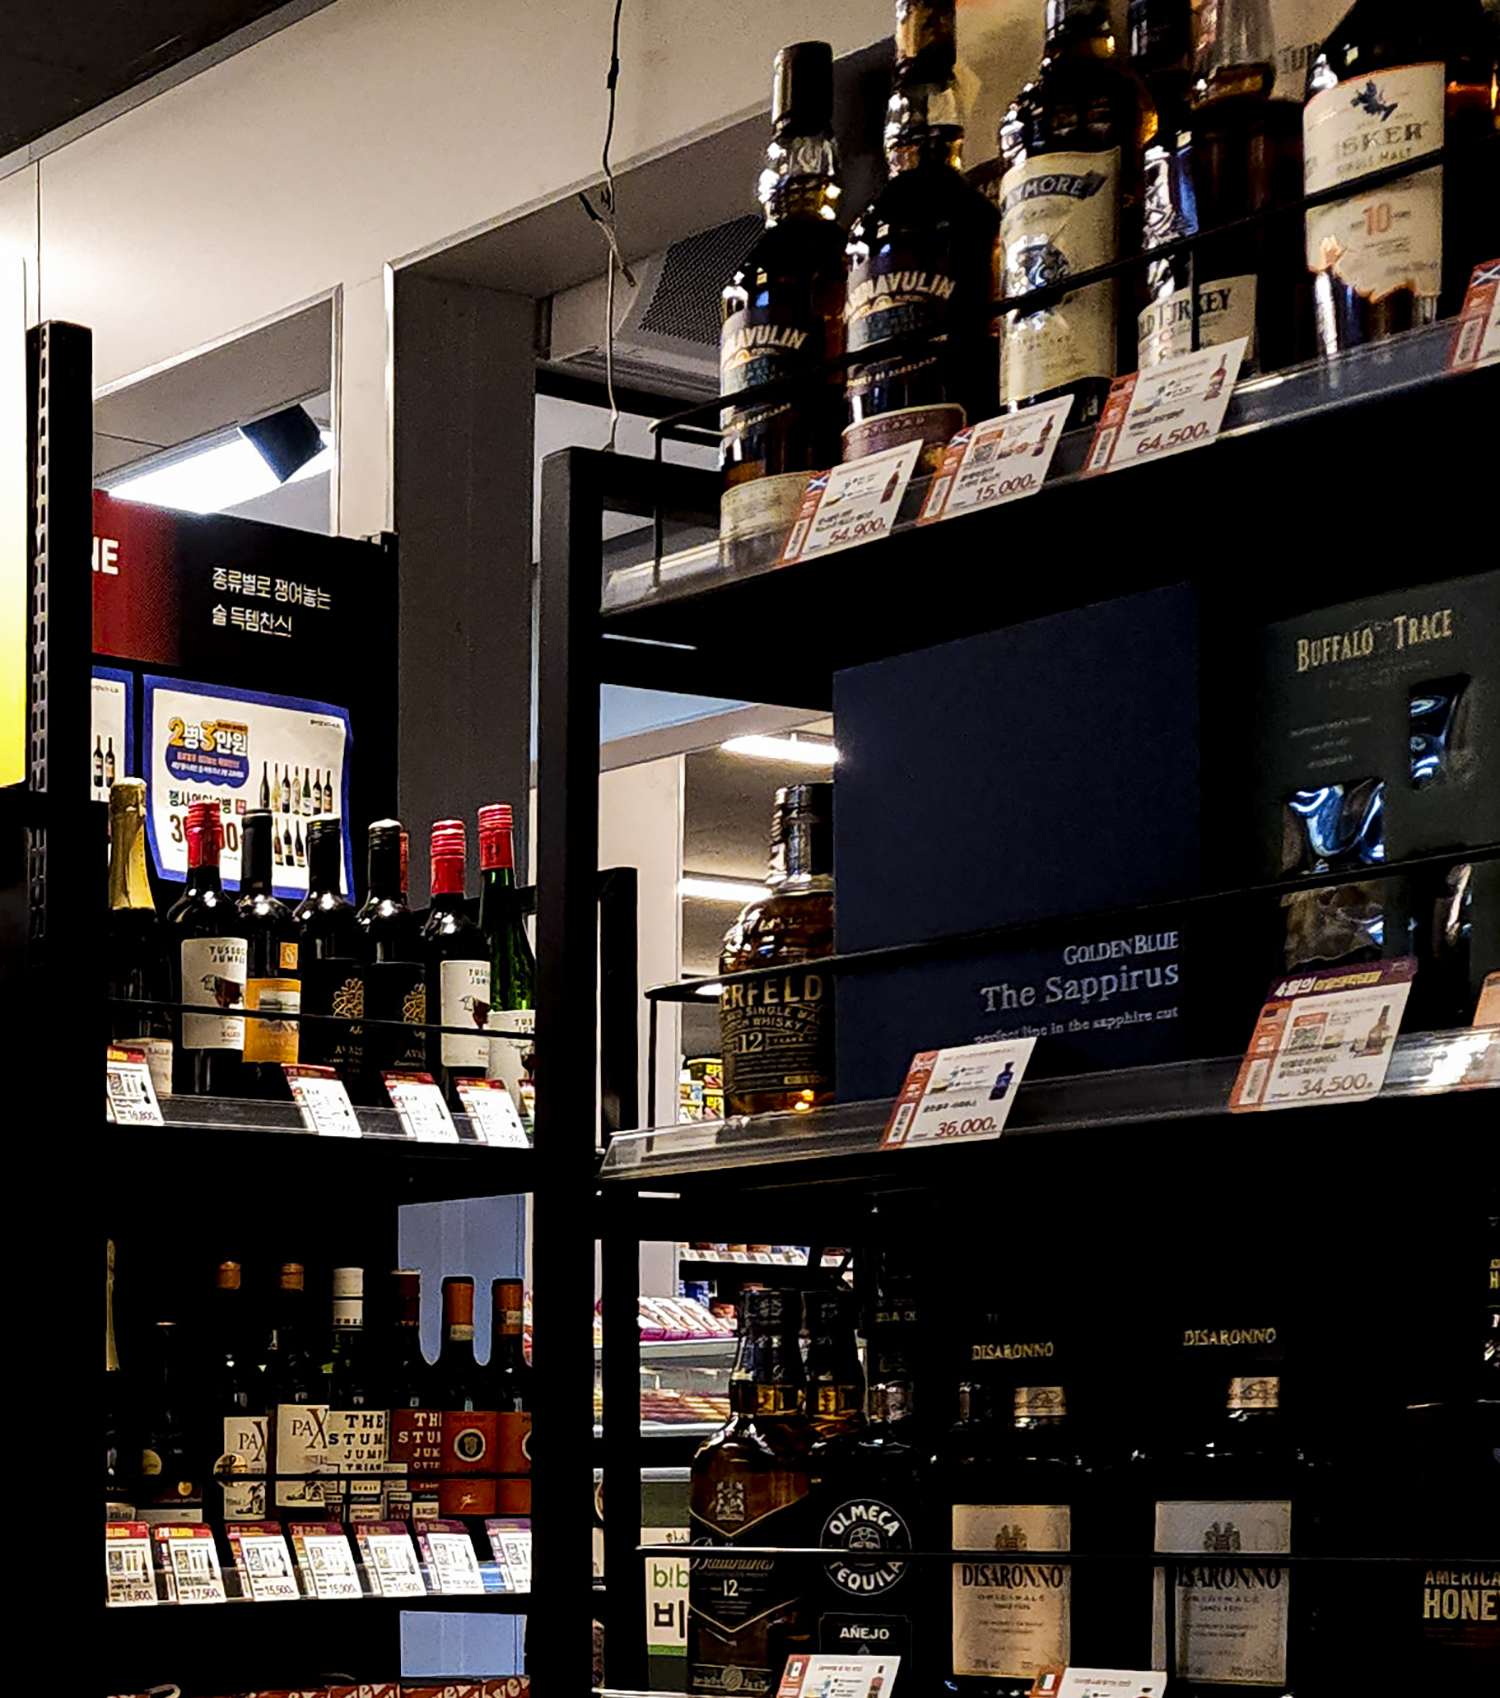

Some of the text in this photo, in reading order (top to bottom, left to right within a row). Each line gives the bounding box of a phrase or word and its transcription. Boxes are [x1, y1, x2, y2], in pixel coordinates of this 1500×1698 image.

[1362, 203, 1391, 235] 10
[213, 566, 331, 610] 종류별로 쟁여놓는
[212, 603, 227, 626] 술
[1296, 609, 1452, 672] BUFFALO TRACE
[980, 963, 1179, 1013] The Sappirus
[745, 1006, 792, 1017] SINGLE
[1051, 1022, 1064, 1035] in
[1068, 1018, 1090, 1032] the
[1093, 1010, 1152, 1031] sapphire
[1156, 1007, 1179, 1020] cut
[740, 1032, 762, 1053] 12
[1184, 1329, 1277, 1346] DISARONNO
[971, 1342, 1054, 1360] DISARONNO
[292, 1408, 329, 1449] PAX
[345, 1414, 383, 1428] THE
[829, 1505, 900, 1537] OLMECA
[723, 1579, 739, 1597] 12
[829, 1561, 904, 1591] TEQUILA
[962, 1564, 1063, 1589] DISARONNO
[1423, 1588, 1500, 1621] HONE
[839, 1624, 890, 1640] AÑEJO
